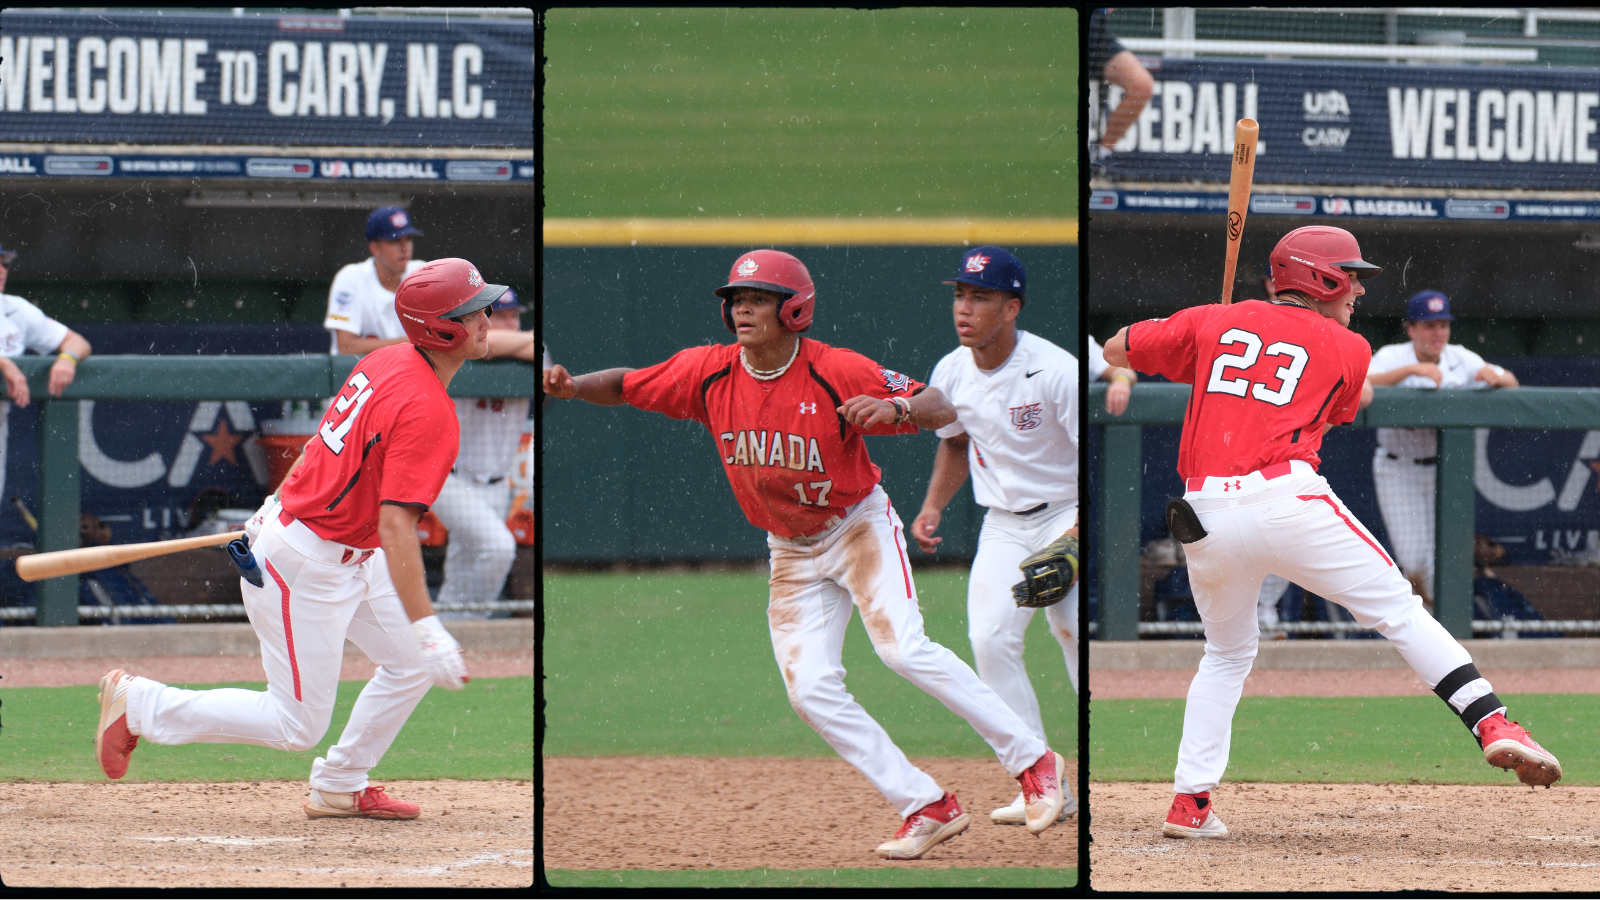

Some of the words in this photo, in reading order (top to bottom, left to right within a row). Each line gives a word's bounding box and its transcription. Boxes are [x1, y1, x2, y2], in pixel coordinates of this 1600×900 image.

[0, 36, 209, 115] WELCOME
[217, 50, 258, 106] TO
[267, 41, 396, 127] CARY,
[406, 43, 497, 119] N.C.
[1302, 127, 1351, 148] CARY
[1387, 87, 1600, 164] WELCOME
[0, 157, 37, 173] ALL
[352, 162, 439, 179] BASEBALL
[1353, 200, 1439, 217] BASEBALL
[1205, 327, 1310, 407] 23
[319, 371, 374, 457] 21
[720, 430, 826, 474] CANADA
[793, 479, 832, 507] 17
